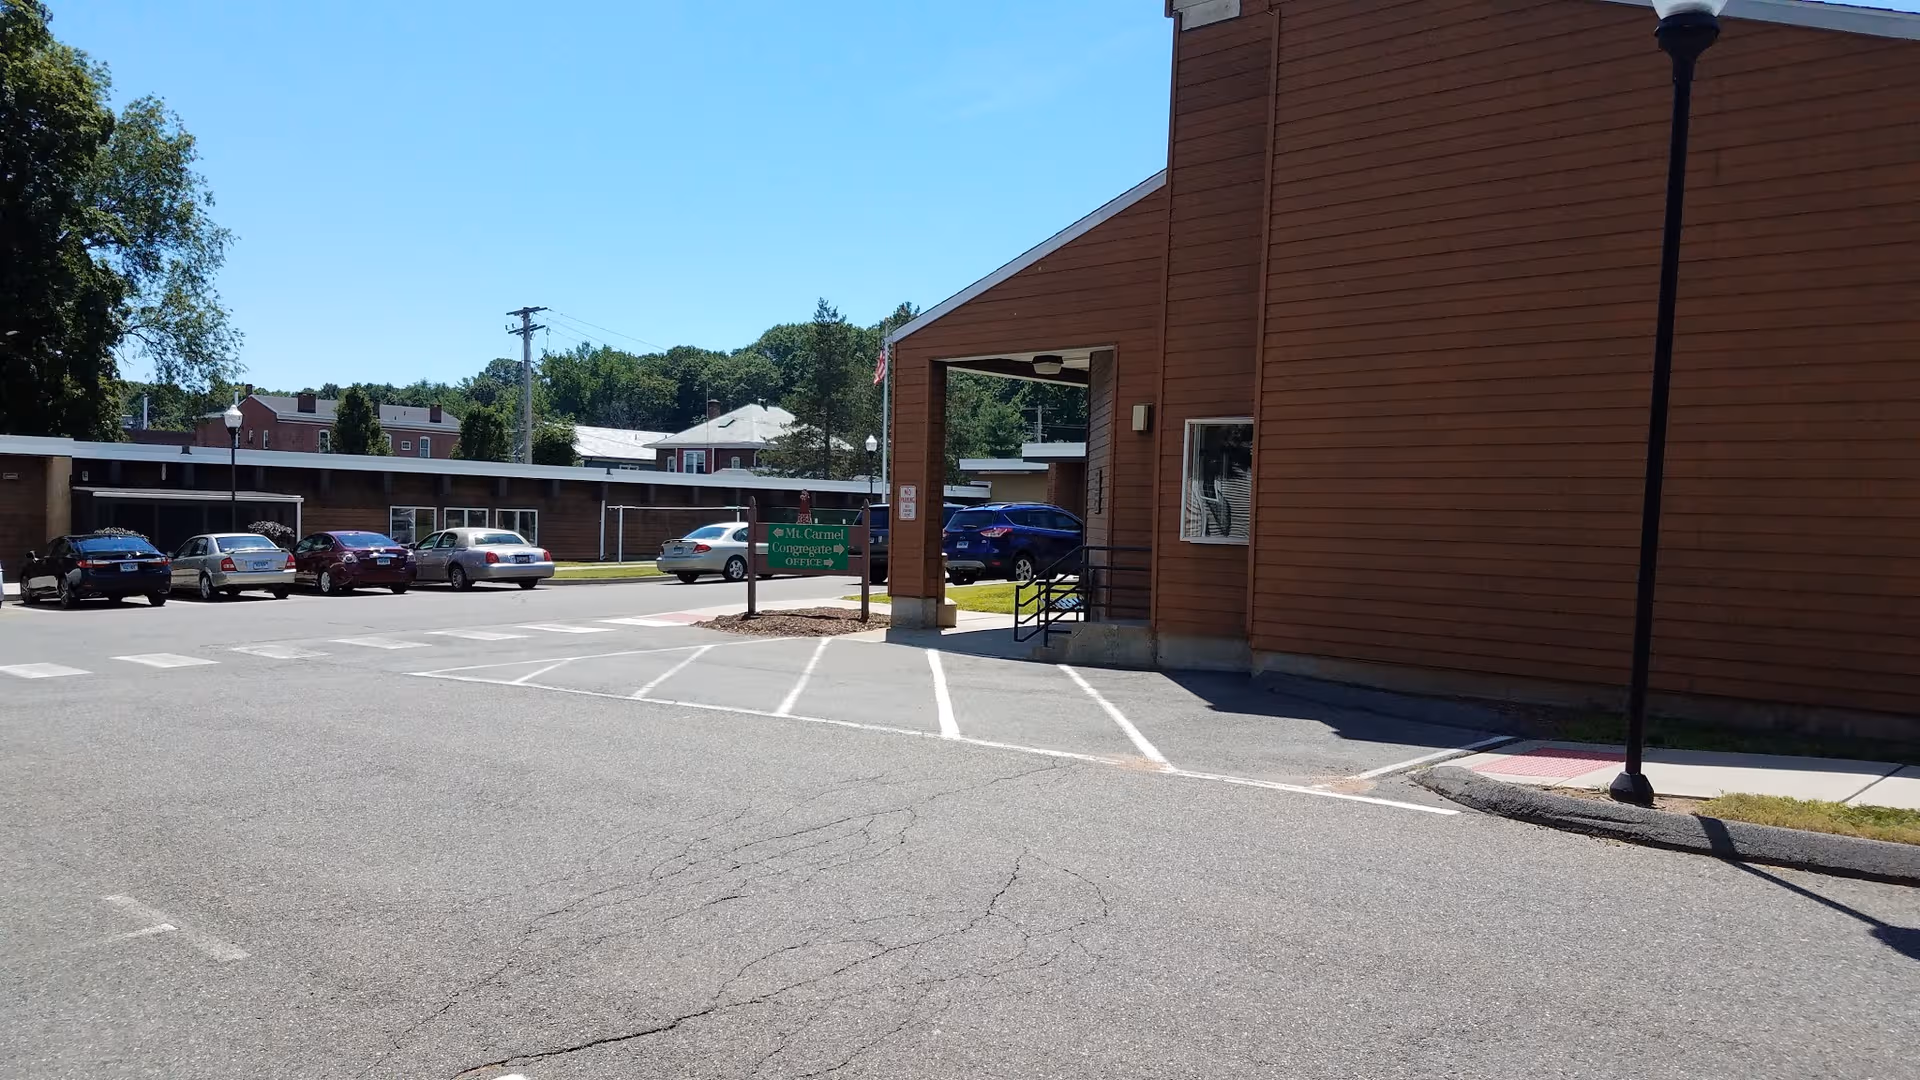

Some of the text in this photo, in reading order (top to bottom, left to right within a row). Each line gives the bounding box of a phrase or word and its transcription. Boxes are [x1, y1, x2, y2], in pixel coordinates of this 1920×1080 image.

[785, 527, 844, 540] Mt. Carmel
[772, 542, 832, 558] Congregate
[785, 557, 823, 566] OFFICE
